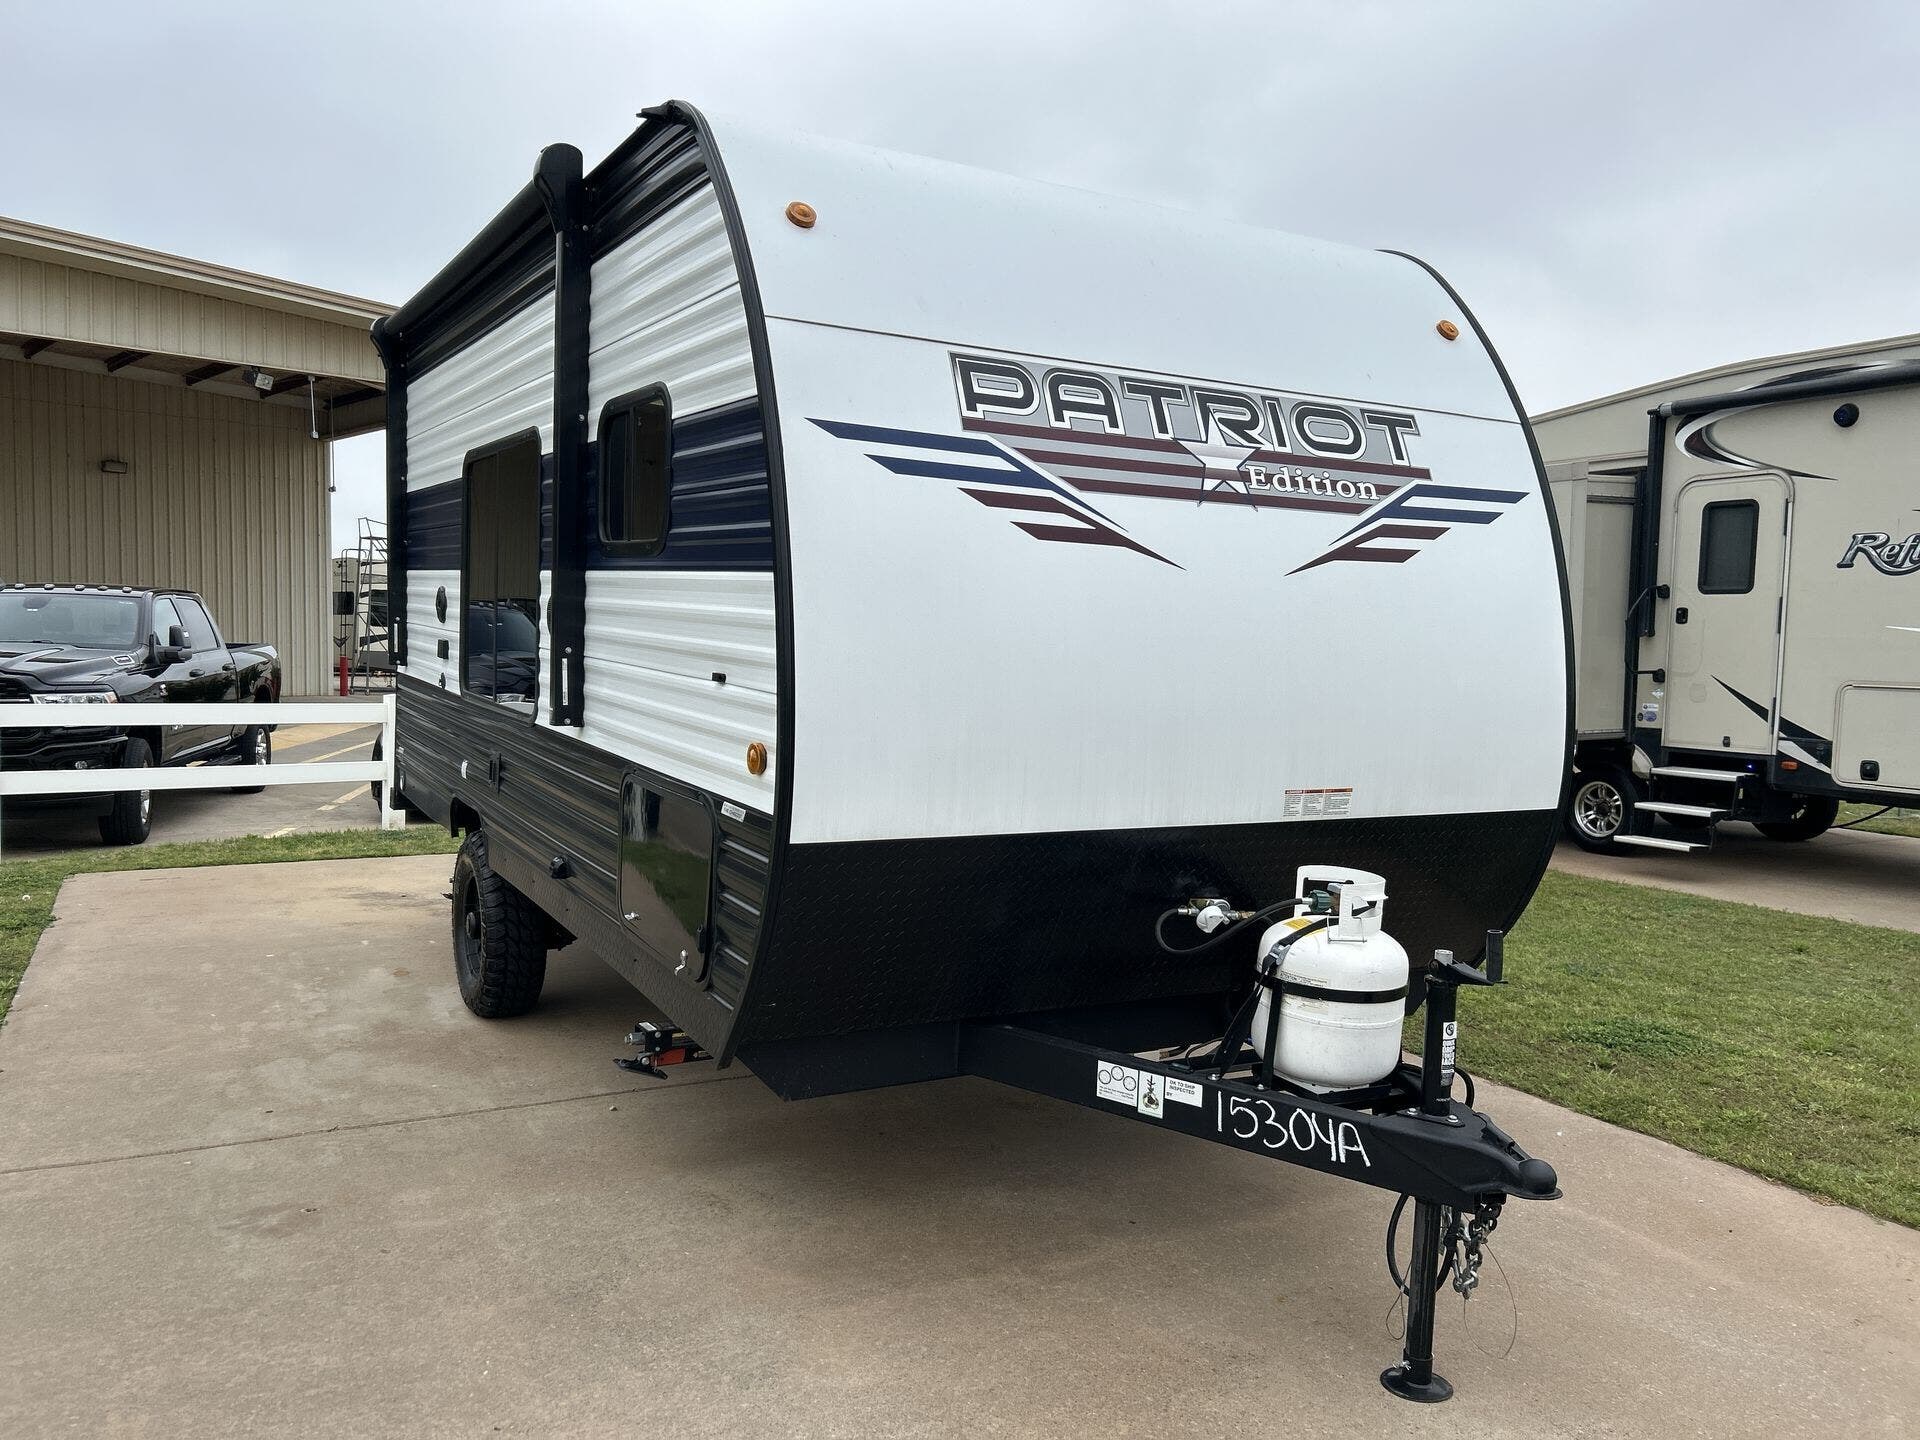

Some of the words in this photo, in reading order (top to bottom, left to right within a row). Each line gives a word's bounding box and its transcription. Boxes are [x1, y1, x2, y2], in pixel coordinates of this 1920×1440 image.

[952, 353, 1421, 467] PATRIOT
[1245, 464, 1380, 500] Edition
[1169, 1085, 1195, 1095] INSPECTED
[1217, 1090, 1371, 1167] 15304A
